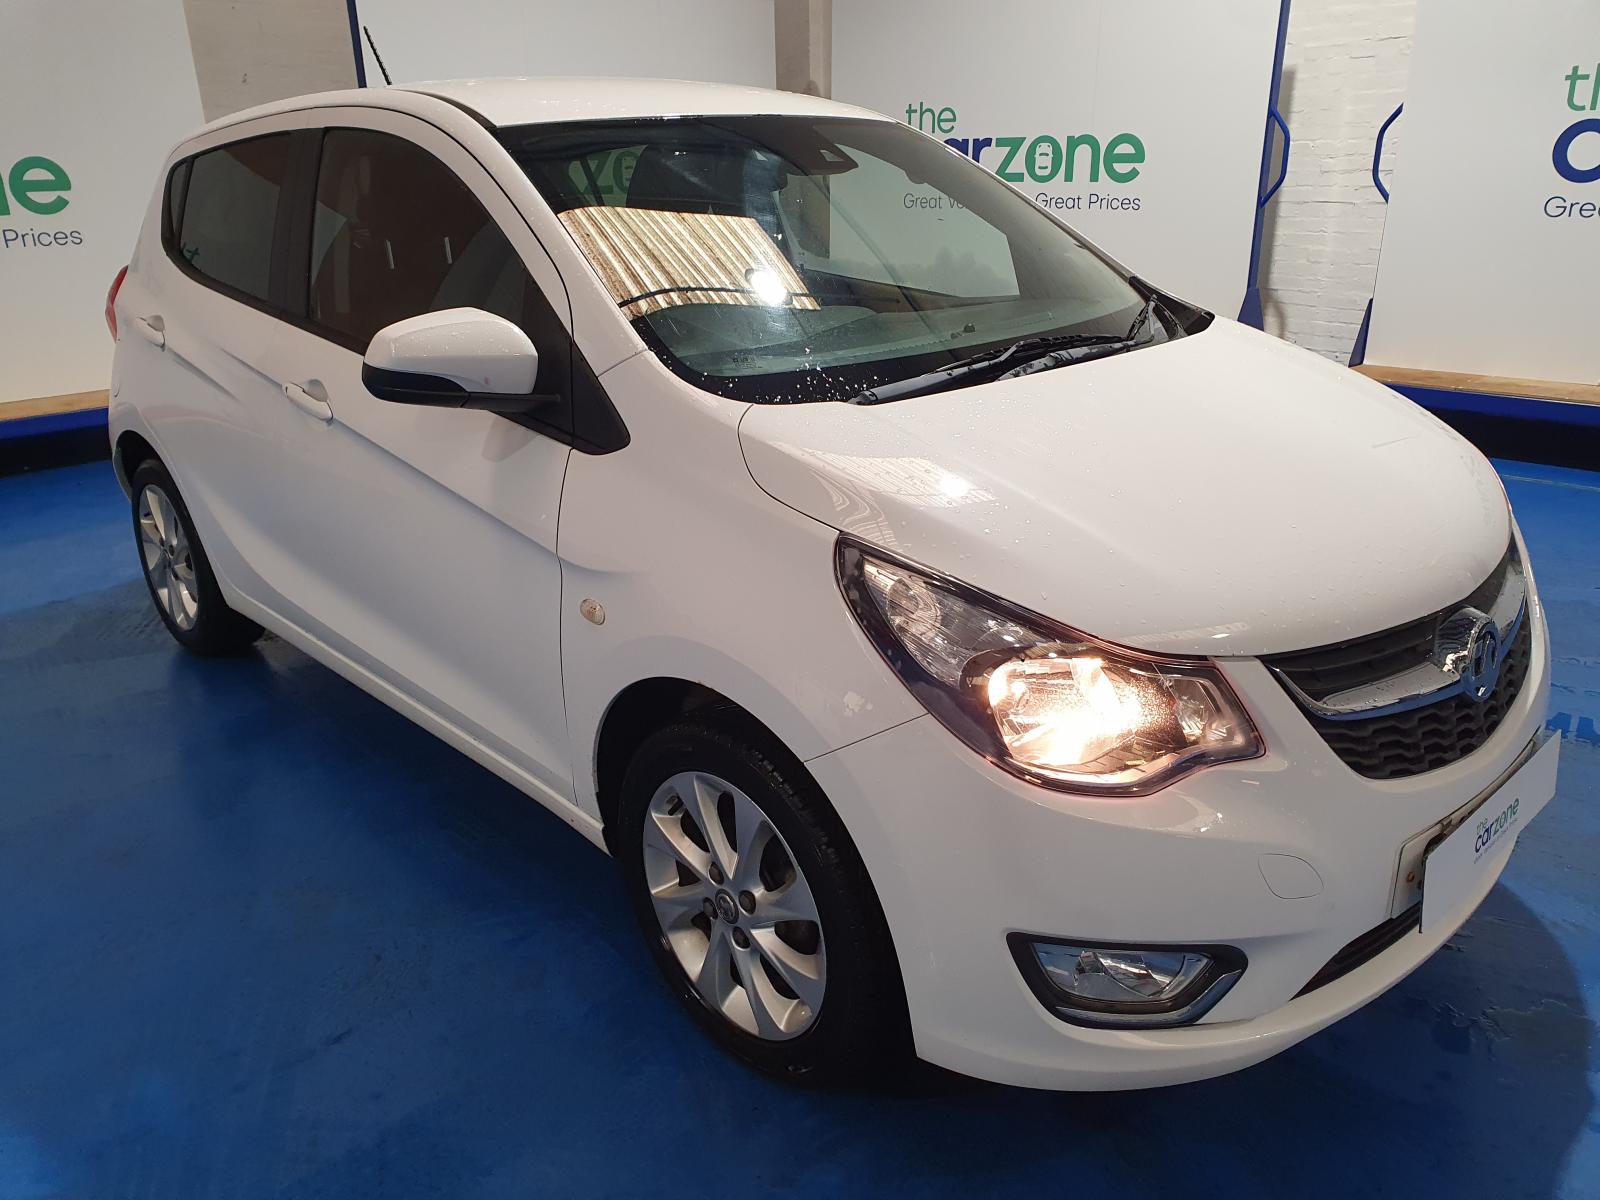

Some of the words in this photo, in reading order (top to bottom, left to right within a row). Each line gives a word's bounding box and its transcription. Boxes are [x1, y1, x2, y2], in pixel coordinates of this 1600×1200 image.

[905, 101, 957, 134] the
[903, 192, 943, 209] Great
[1035, 192, 1082, 210] Great
[1088, 193, 1141, 211] Prices
[1544, 196, 1600, 218] Gre
[2, 227, 83, 249] Prices
[1475, 797, 1520, 853] carzone
